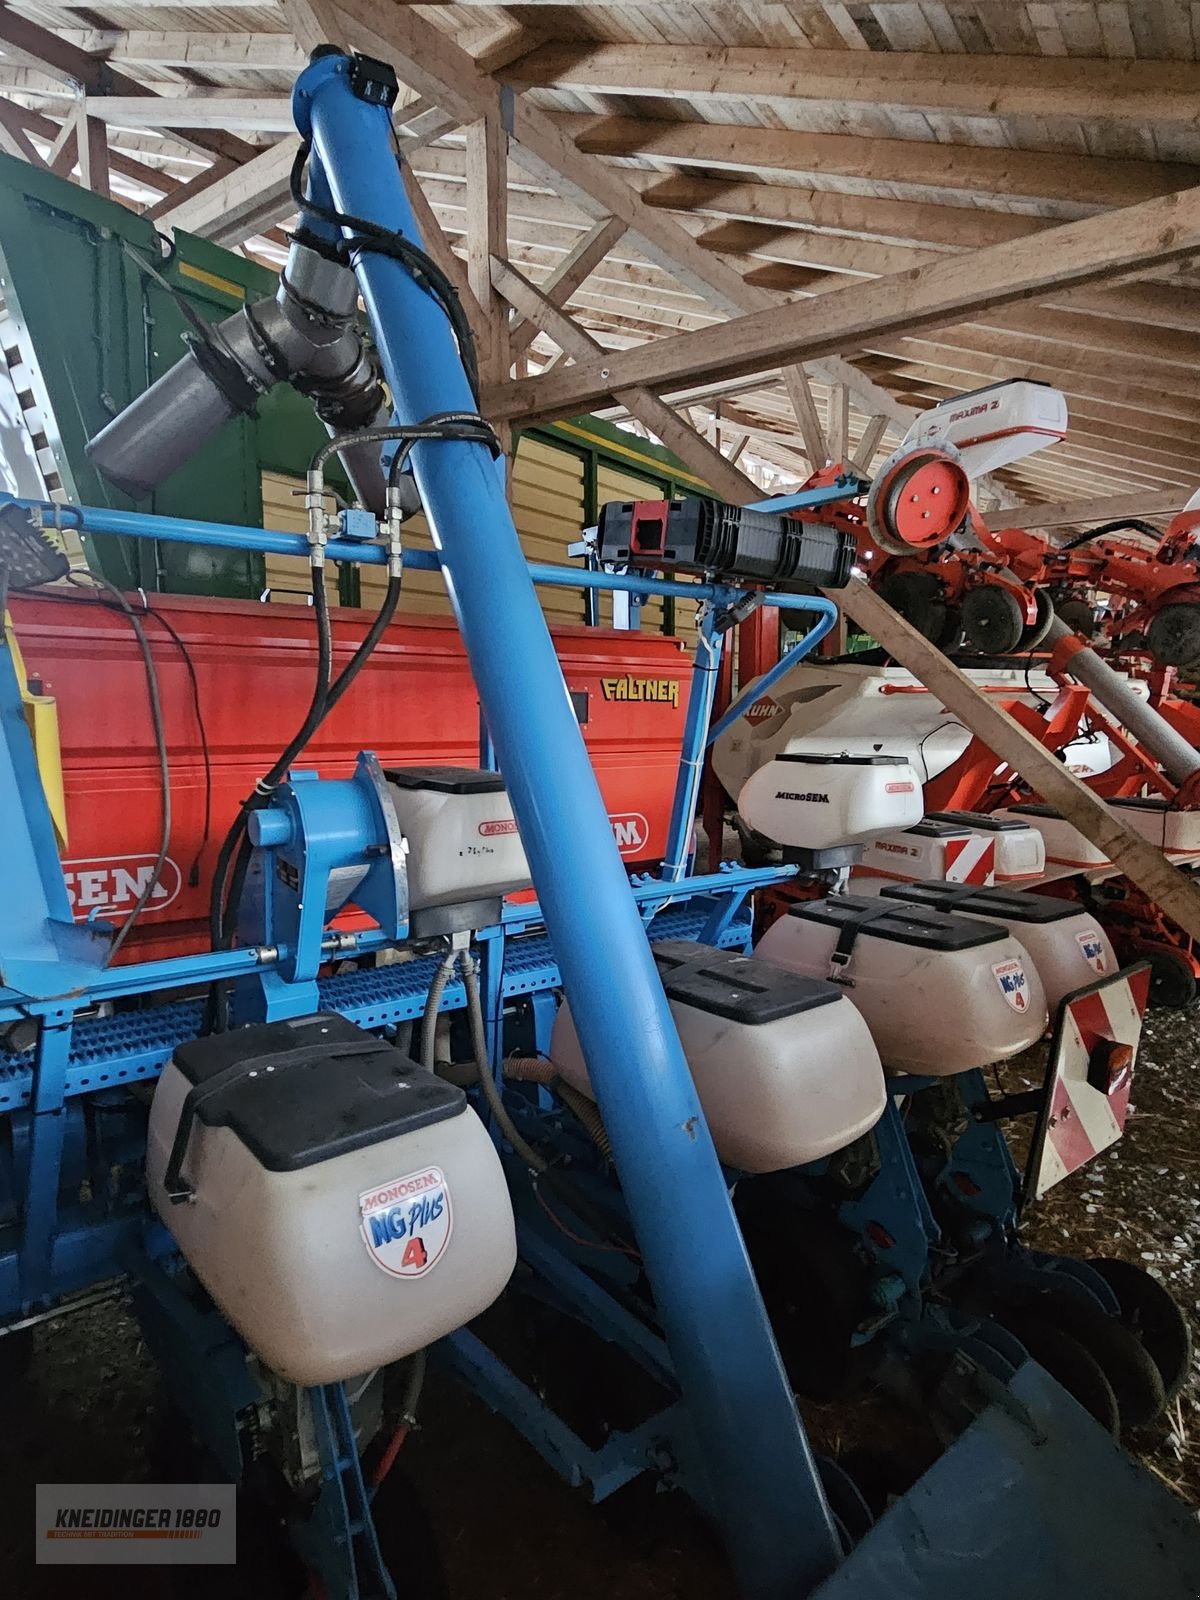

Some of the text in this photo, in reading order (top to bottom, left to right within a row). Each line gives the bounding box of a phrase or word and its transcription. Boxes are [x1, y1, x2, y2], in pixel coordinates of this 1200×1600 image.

[949, 400, 1000, 423] MAXIMA 2
[600, 673, 680, 709] FALTNER
[875, 841, 918, 857] MAXIMA 2
[1015, 991, 1025, 1008] 4
[363, 1173, 439, 1211] MONOSEM
[369, 1206, 407, 1248] NG
[401, 1236, 428, 1269] 4
